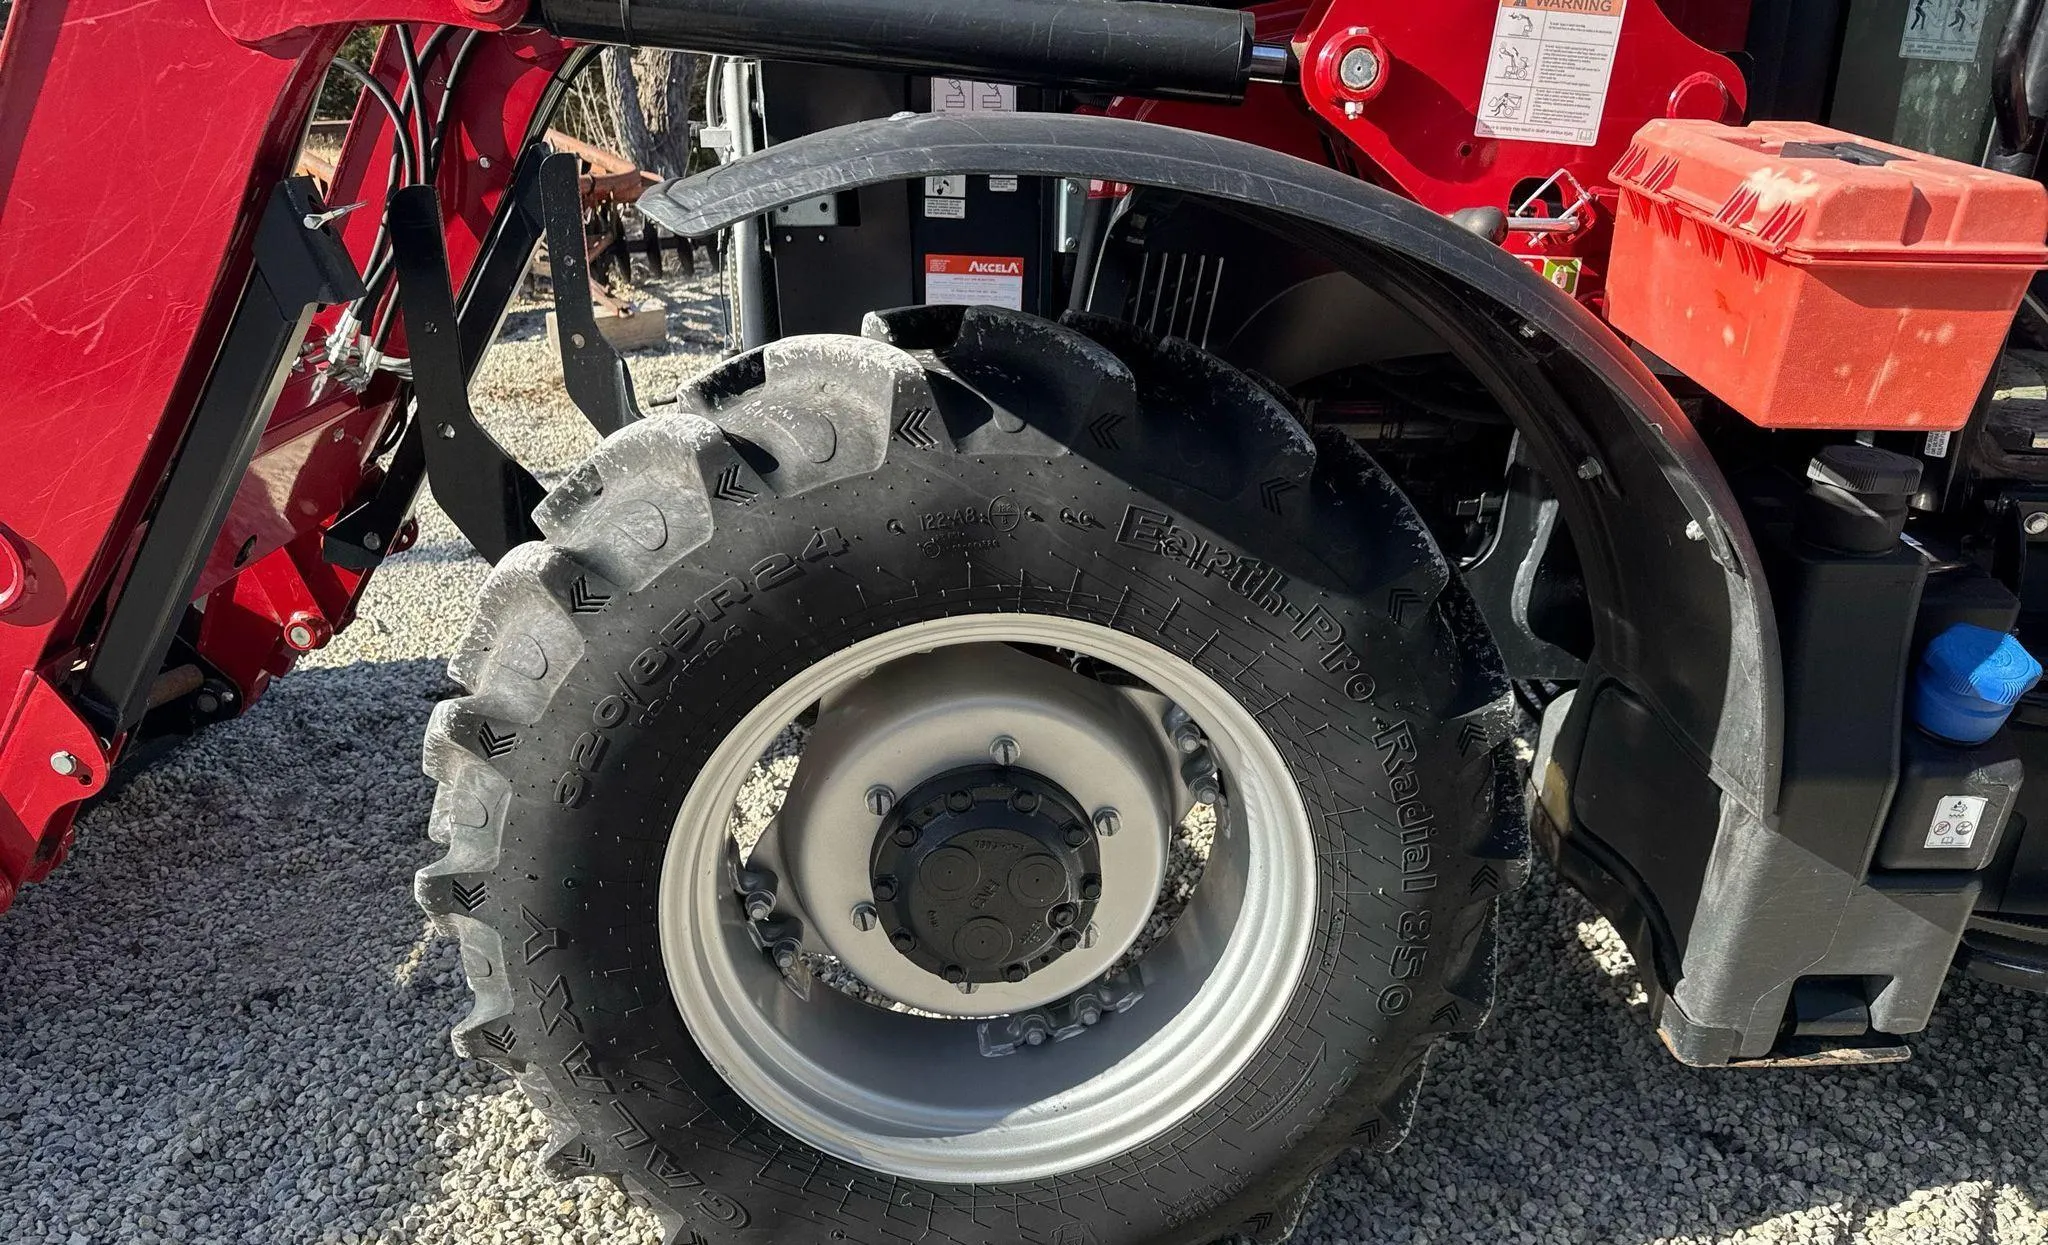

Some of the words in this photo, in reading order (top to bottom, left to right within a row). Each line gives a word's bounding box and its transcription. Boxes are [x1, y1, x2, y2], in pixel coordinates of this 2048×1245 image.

[1537, 0, 1612, 12] WARNING
[968, 260, 1019, 274] AKCELA
[553, 526, 850, 808] 320/85R24
[1371, 719, 1438, 892] Radial
[1376, 910, 1433, 1016] 850
[519, 904, 750, 1229] GALAXY
